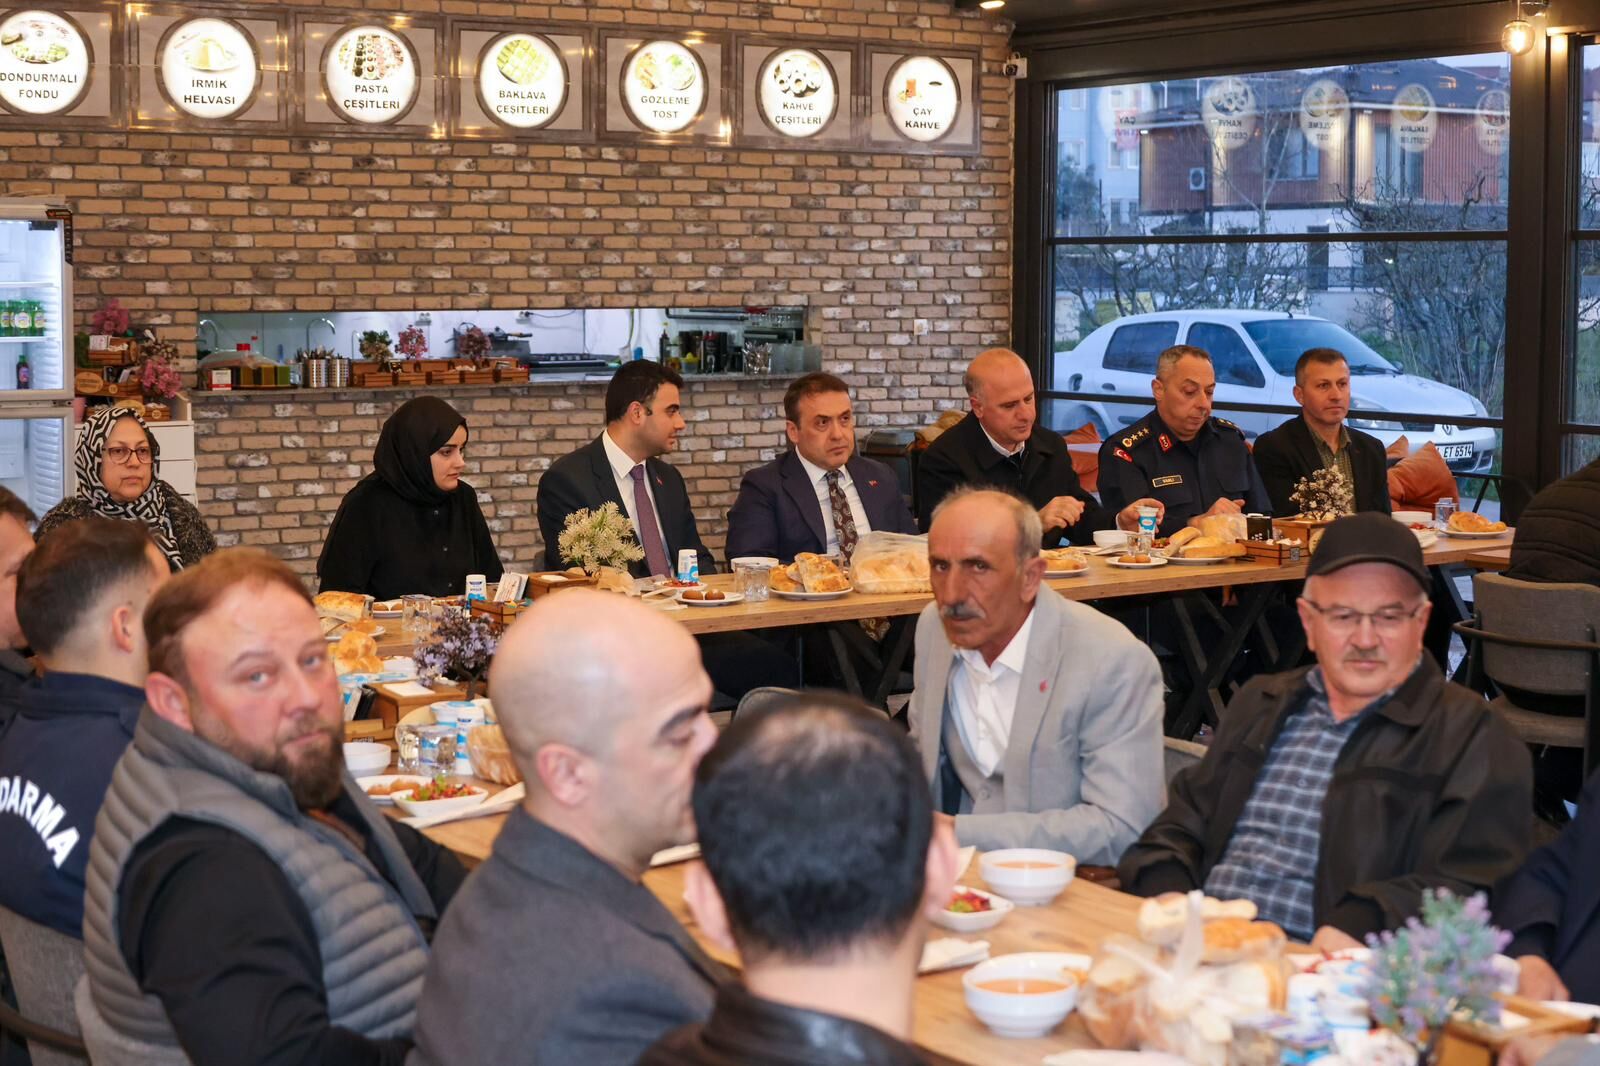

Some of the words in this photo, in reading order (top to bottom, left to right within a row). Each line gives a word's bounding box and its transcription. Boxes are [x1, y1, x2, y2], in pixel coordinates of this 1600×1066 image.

[0, 72, 77, 83] DONDURMALI
[19, 89, 59, 99] FONDU
[354, 84, 389, 94] PASTA
[184, 94, 235, 105] HELVASI
[499, 90, 546, 100] BAKLAVA
[782, 102, 814, 111] KAHVE
[912, 107, 933, 116] ÇAY
[652, 110, 679, 119] TOST
[904, 120, 941, 130] KAHVE
[1443, 446, 1454, 458] ET
[1455, 445, 1472, 457] 6514
